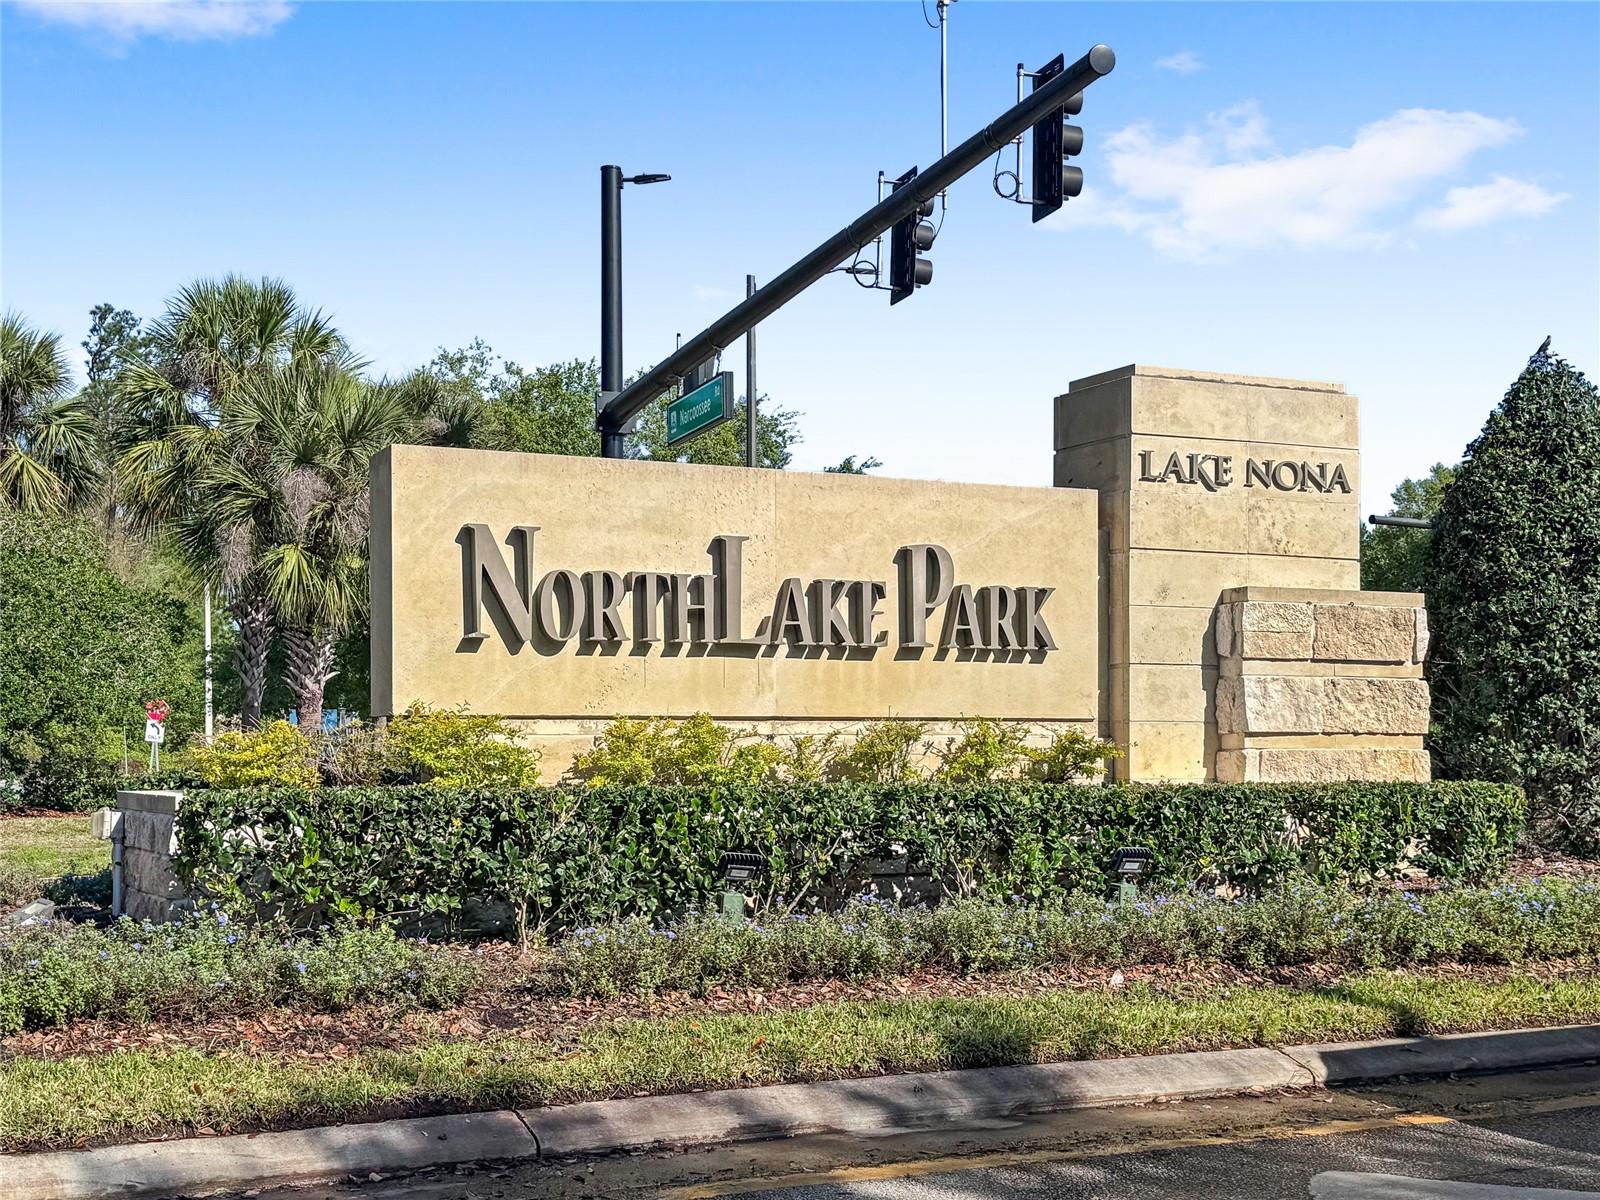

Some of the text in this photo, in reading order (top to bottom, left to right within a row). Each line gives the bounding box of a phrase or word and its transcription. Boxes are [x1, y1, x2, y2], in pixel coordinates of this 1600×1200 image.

[679, 398, 711, 425] Narcoossee
[1138, 450, 1354, 494] LAKE NONA
[892, 543, 1059, 664] PARK
